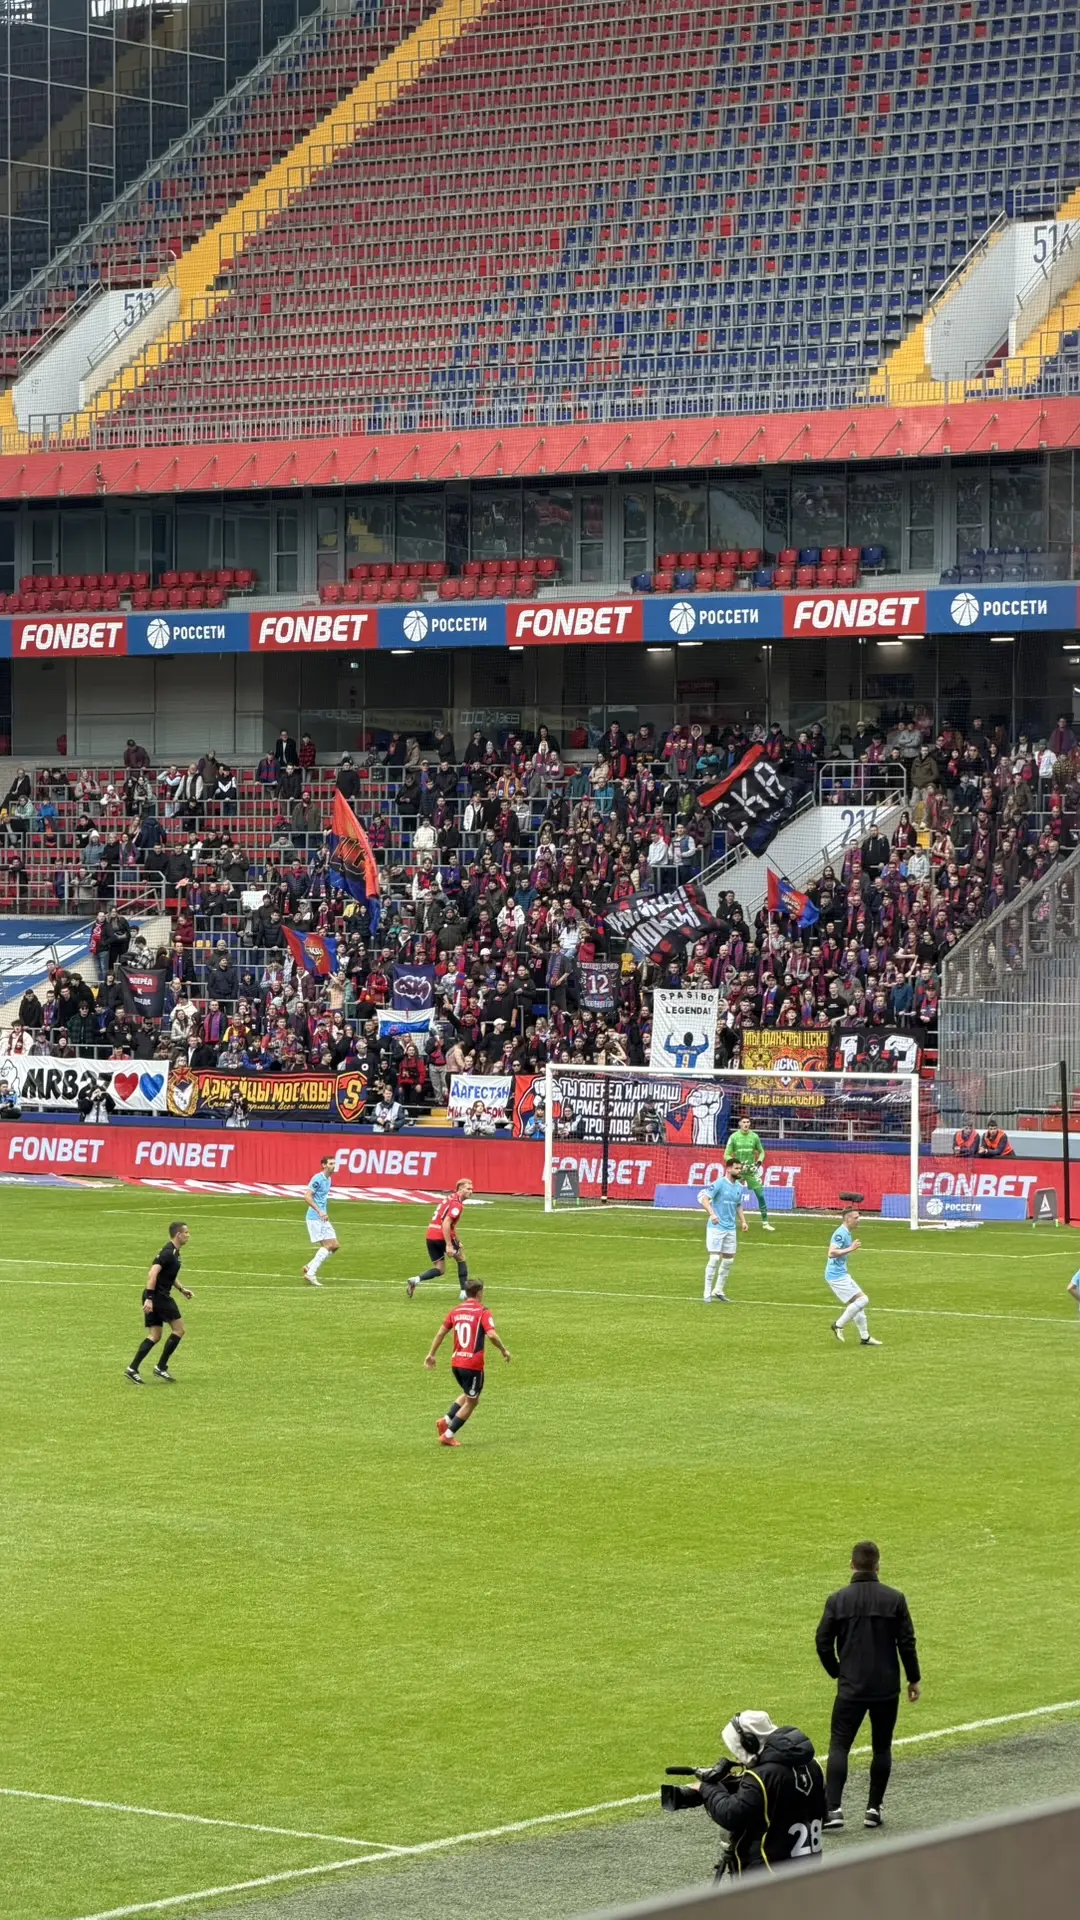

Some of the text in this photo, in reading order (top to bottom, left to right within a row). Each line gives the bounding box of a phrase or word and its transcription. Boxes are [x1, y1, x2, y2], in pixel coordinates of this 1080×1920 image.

[699, 609, 759, 625] РОССЕТИ
[793, 597, 920, 629] FONBET
[983, 600, 1048, 616] РОССЕТИ
[173, 624, 226, 640] РОССЕТИ
[259, 614, 368, 644] FONBET
[431, 617, 487, 632] РОССЕТИ
[515, 606, 633, 637] FONBET
[20, 622, 123, 650] FONBET
[588, 974, 609, 994] 12
[660, 991, 714, 1002] SPASIBO
[665, 1006, 711, 1015] LEGENDA!
[804, 1031, 829, 1048] ЦСКА
[272, 1081, 332, 1103] МОСКВЫ
[343, 1079, 362, 1110] S
[451, 1080, 510, 1099] ДАГЕСТАН
[562, 1080, 578, 1097] ТЫ
[624, 1083, 648, 1101] ИДИ
[652, 1085, 680, 1101] НАШ
[8, 1136, 104, 1163] FONBET
[135, 1141, 235, 1168] FONBET
[334, 1148, 437, 1176] FONBET
[687, 1162, 802, 1187] FOET
[918, 1171, 1037, 1198] FONBET
[945, 1203, 982, 1212] РОССЕТИ
[455, 1322, 471, 1349] 10
[788, 1818, 822, 1858] 28
